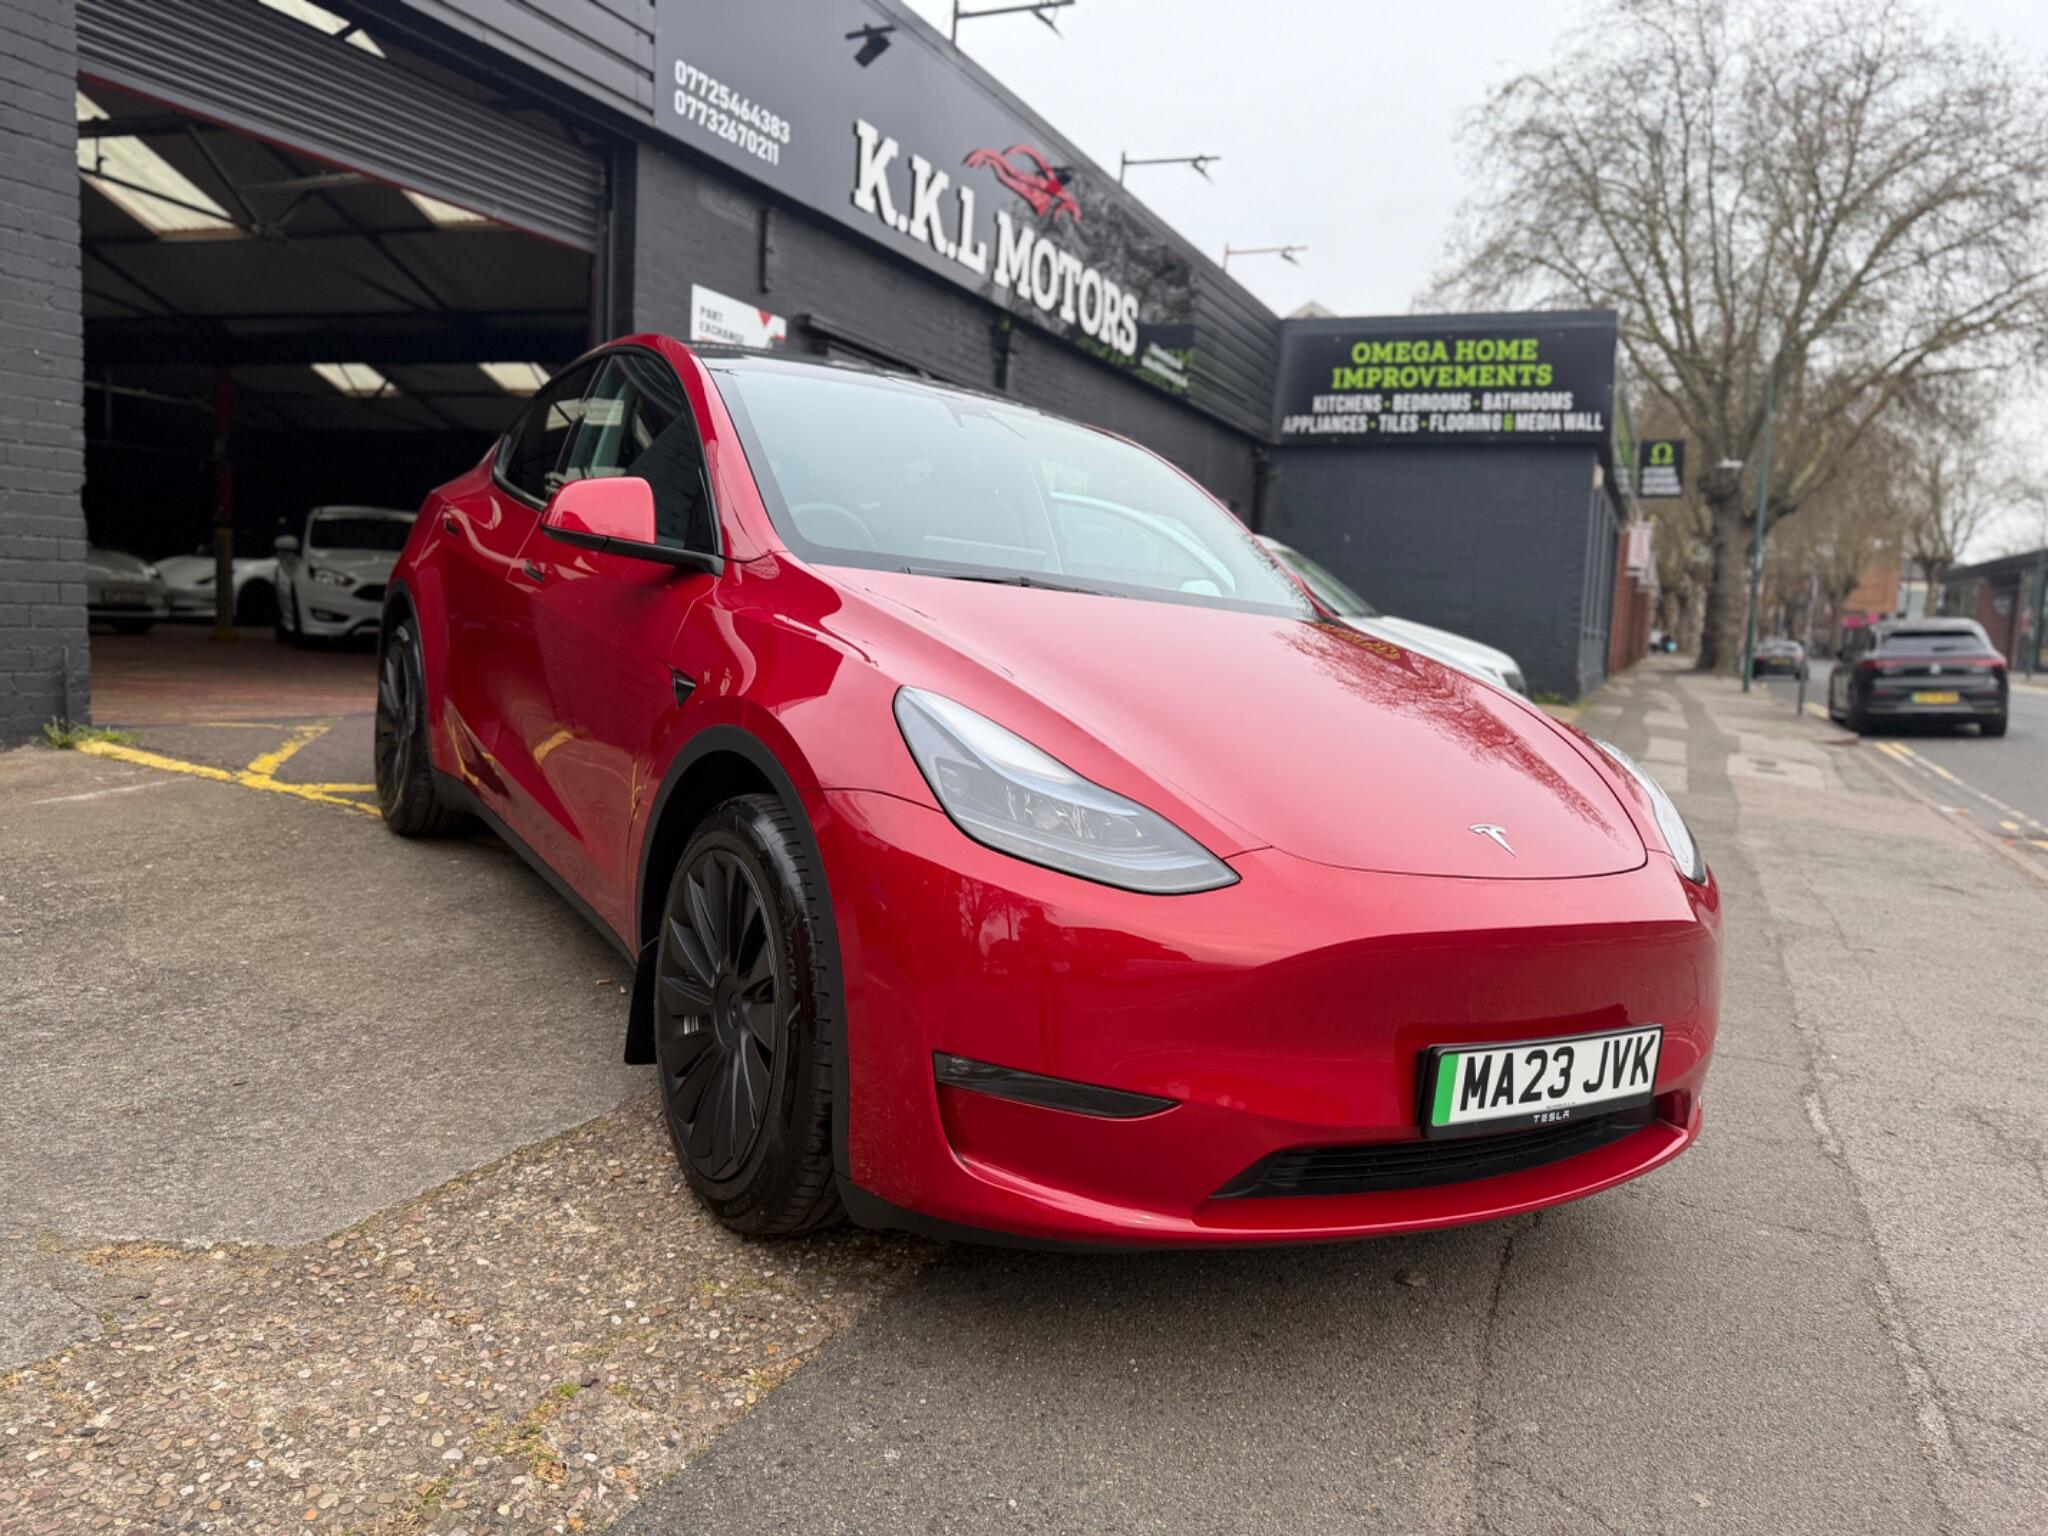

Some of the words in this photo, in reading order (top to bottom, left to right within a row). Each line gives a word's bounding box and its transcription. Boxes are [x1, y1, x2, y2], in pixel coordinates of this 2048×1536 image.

[674, 59, 791, 144] 07725464383
[674, 89, 780, 166] 07732670211
[854, 118, 987, 275] K.K.L
[994, 209, 1139, 356] MOTORS
[1351, 340, 1448, 364] OMEGA
[1455, 338, 1538, 363] HOME
[1331, 364, 1552, 389] IMPROVEMENTS
[1312, 394, 1383, 413] KITCHENS
[1392, 392, 1471, 412] BEDROOMS
[1481, 391, 1573, 411] BATHROOMS
[1282, 414, 1368, 434] APPLIANCES
[1378, 413, 1419, 433] TILES
[1429, 412, 1502, 433] FLOORING
[1515, 412, 1562, 431] MEDIA
[1563, 411, 1604, 431] WALL
[1459, 1046, 1575, 1111] MA23
[1582, 1034, 1656, 1093] JVK
[1533, 1110, 1570, 1124] TESLA
